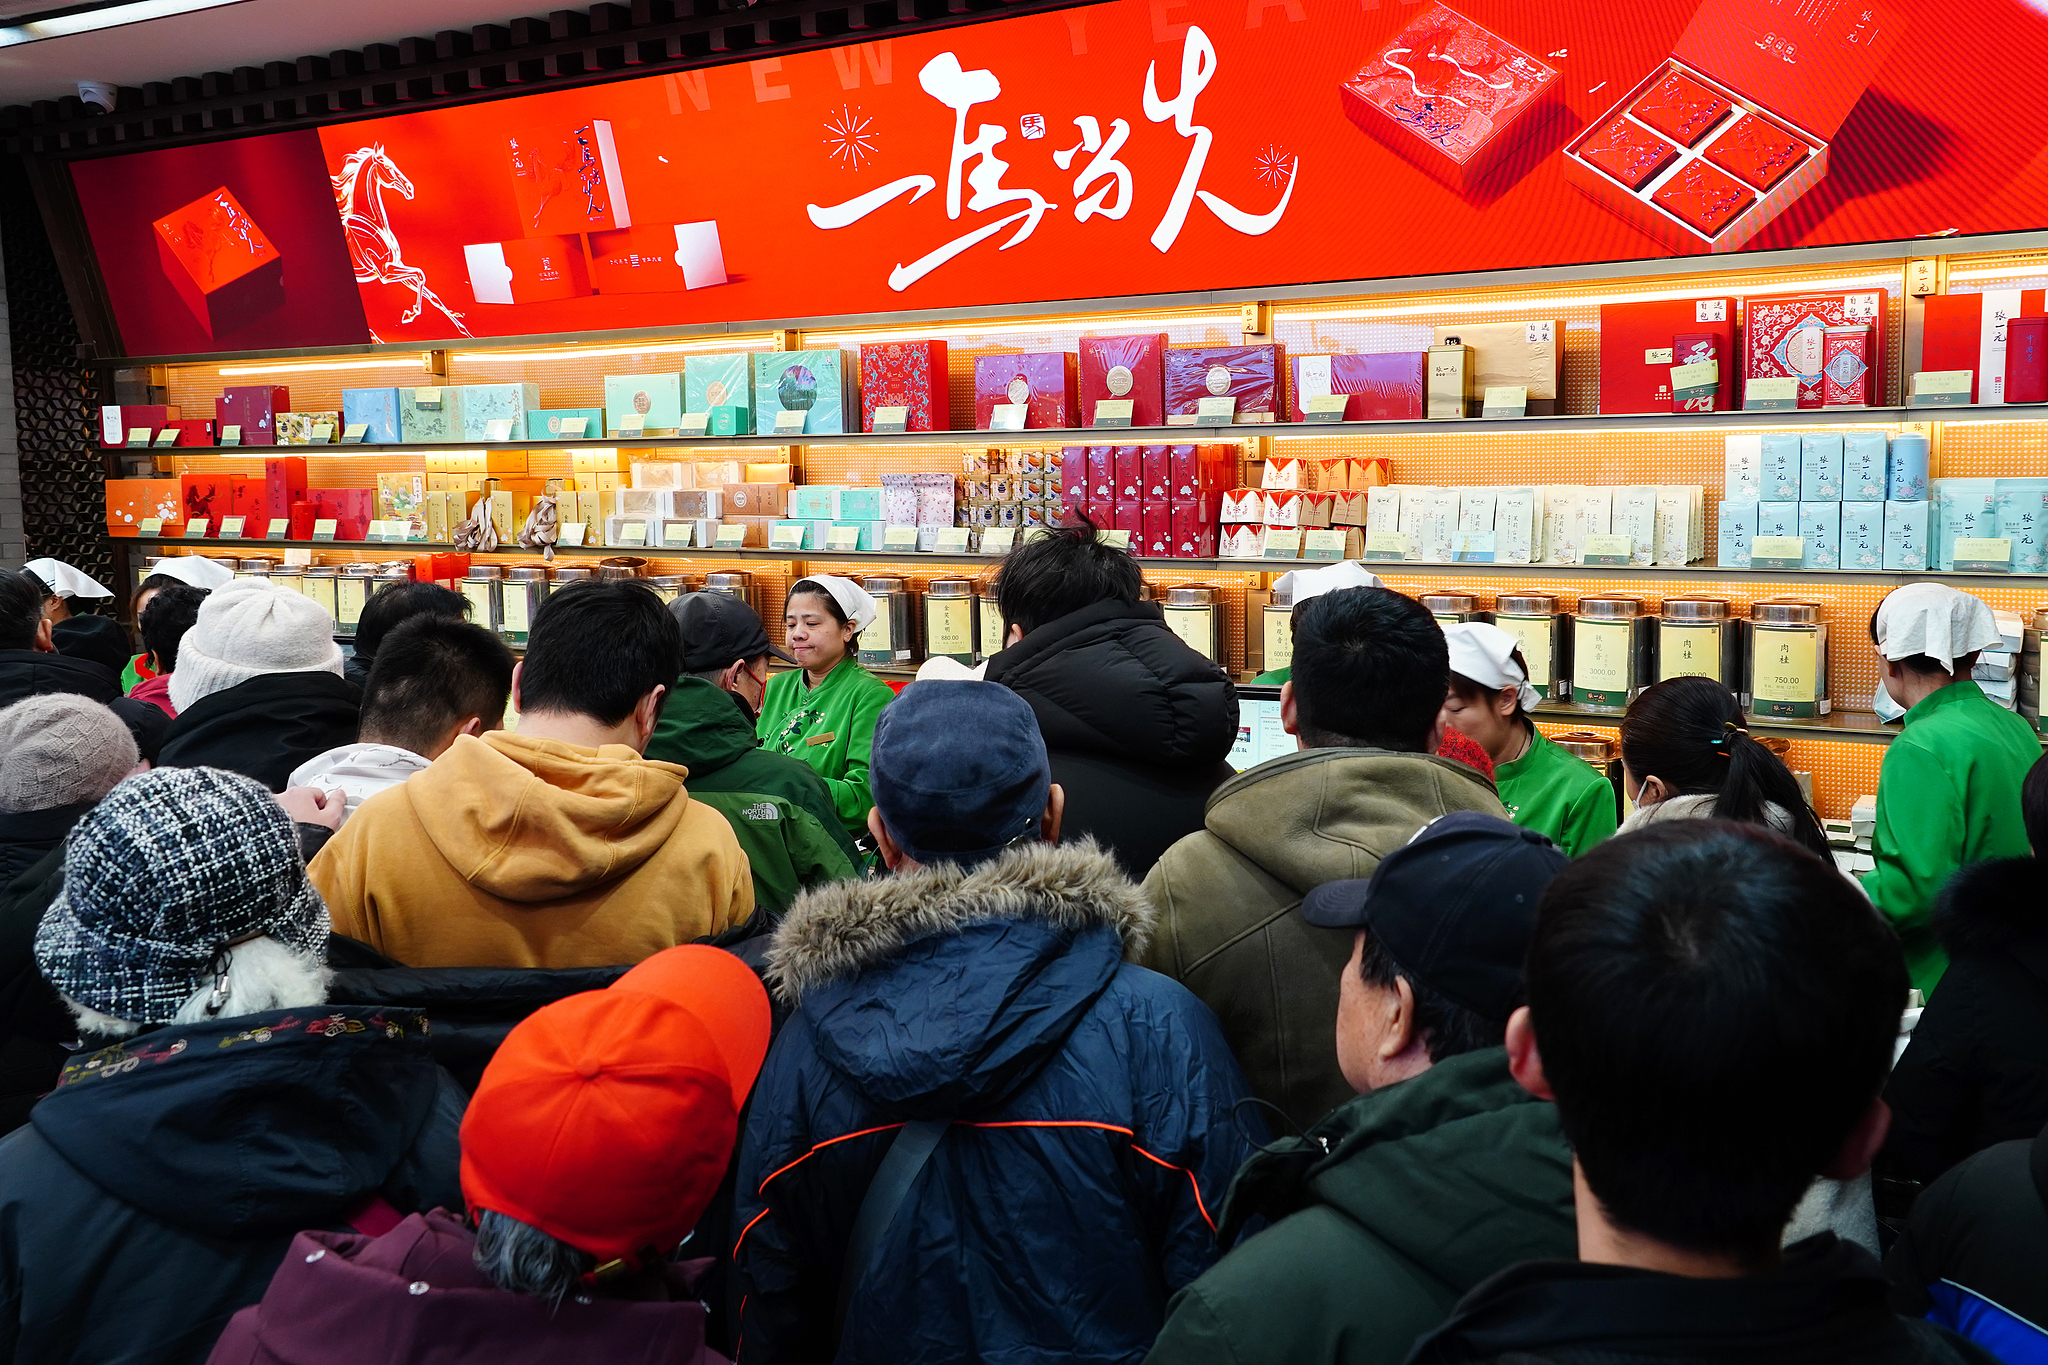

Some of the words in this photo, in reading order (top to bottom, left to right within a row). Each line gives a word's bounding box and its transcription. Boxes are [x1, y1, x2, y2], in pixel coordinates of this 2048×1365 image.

[1917, 265, 1930, 292] 张一元
[1993, 309, 2007, 342] 张一元
[1741, 456, 1750, 481] 张一元
[1777, 455, 1786, 481] 张一元
[1818, 455, 1829, 481] 张一元
[1861, 454, 1871, 480] 张一元
[1735, 522, 1744, 548] 张一元
[1776, 522, 1784, 537] 张一
[1815, 523, 1826, 549] 张一元
[1858, 523, 1869, 549] 张一元
[1902, 523, 1913, 549] 张一元
[1964, 512, 1976, 538] 张一
[2021, 512, 2035, 544] 张一元
[1682, 639, 1692, 659] 肉桂
[1779, 643, 1789, 664] 肉桂
[1589, 668, 1616, 676] 3000.00
